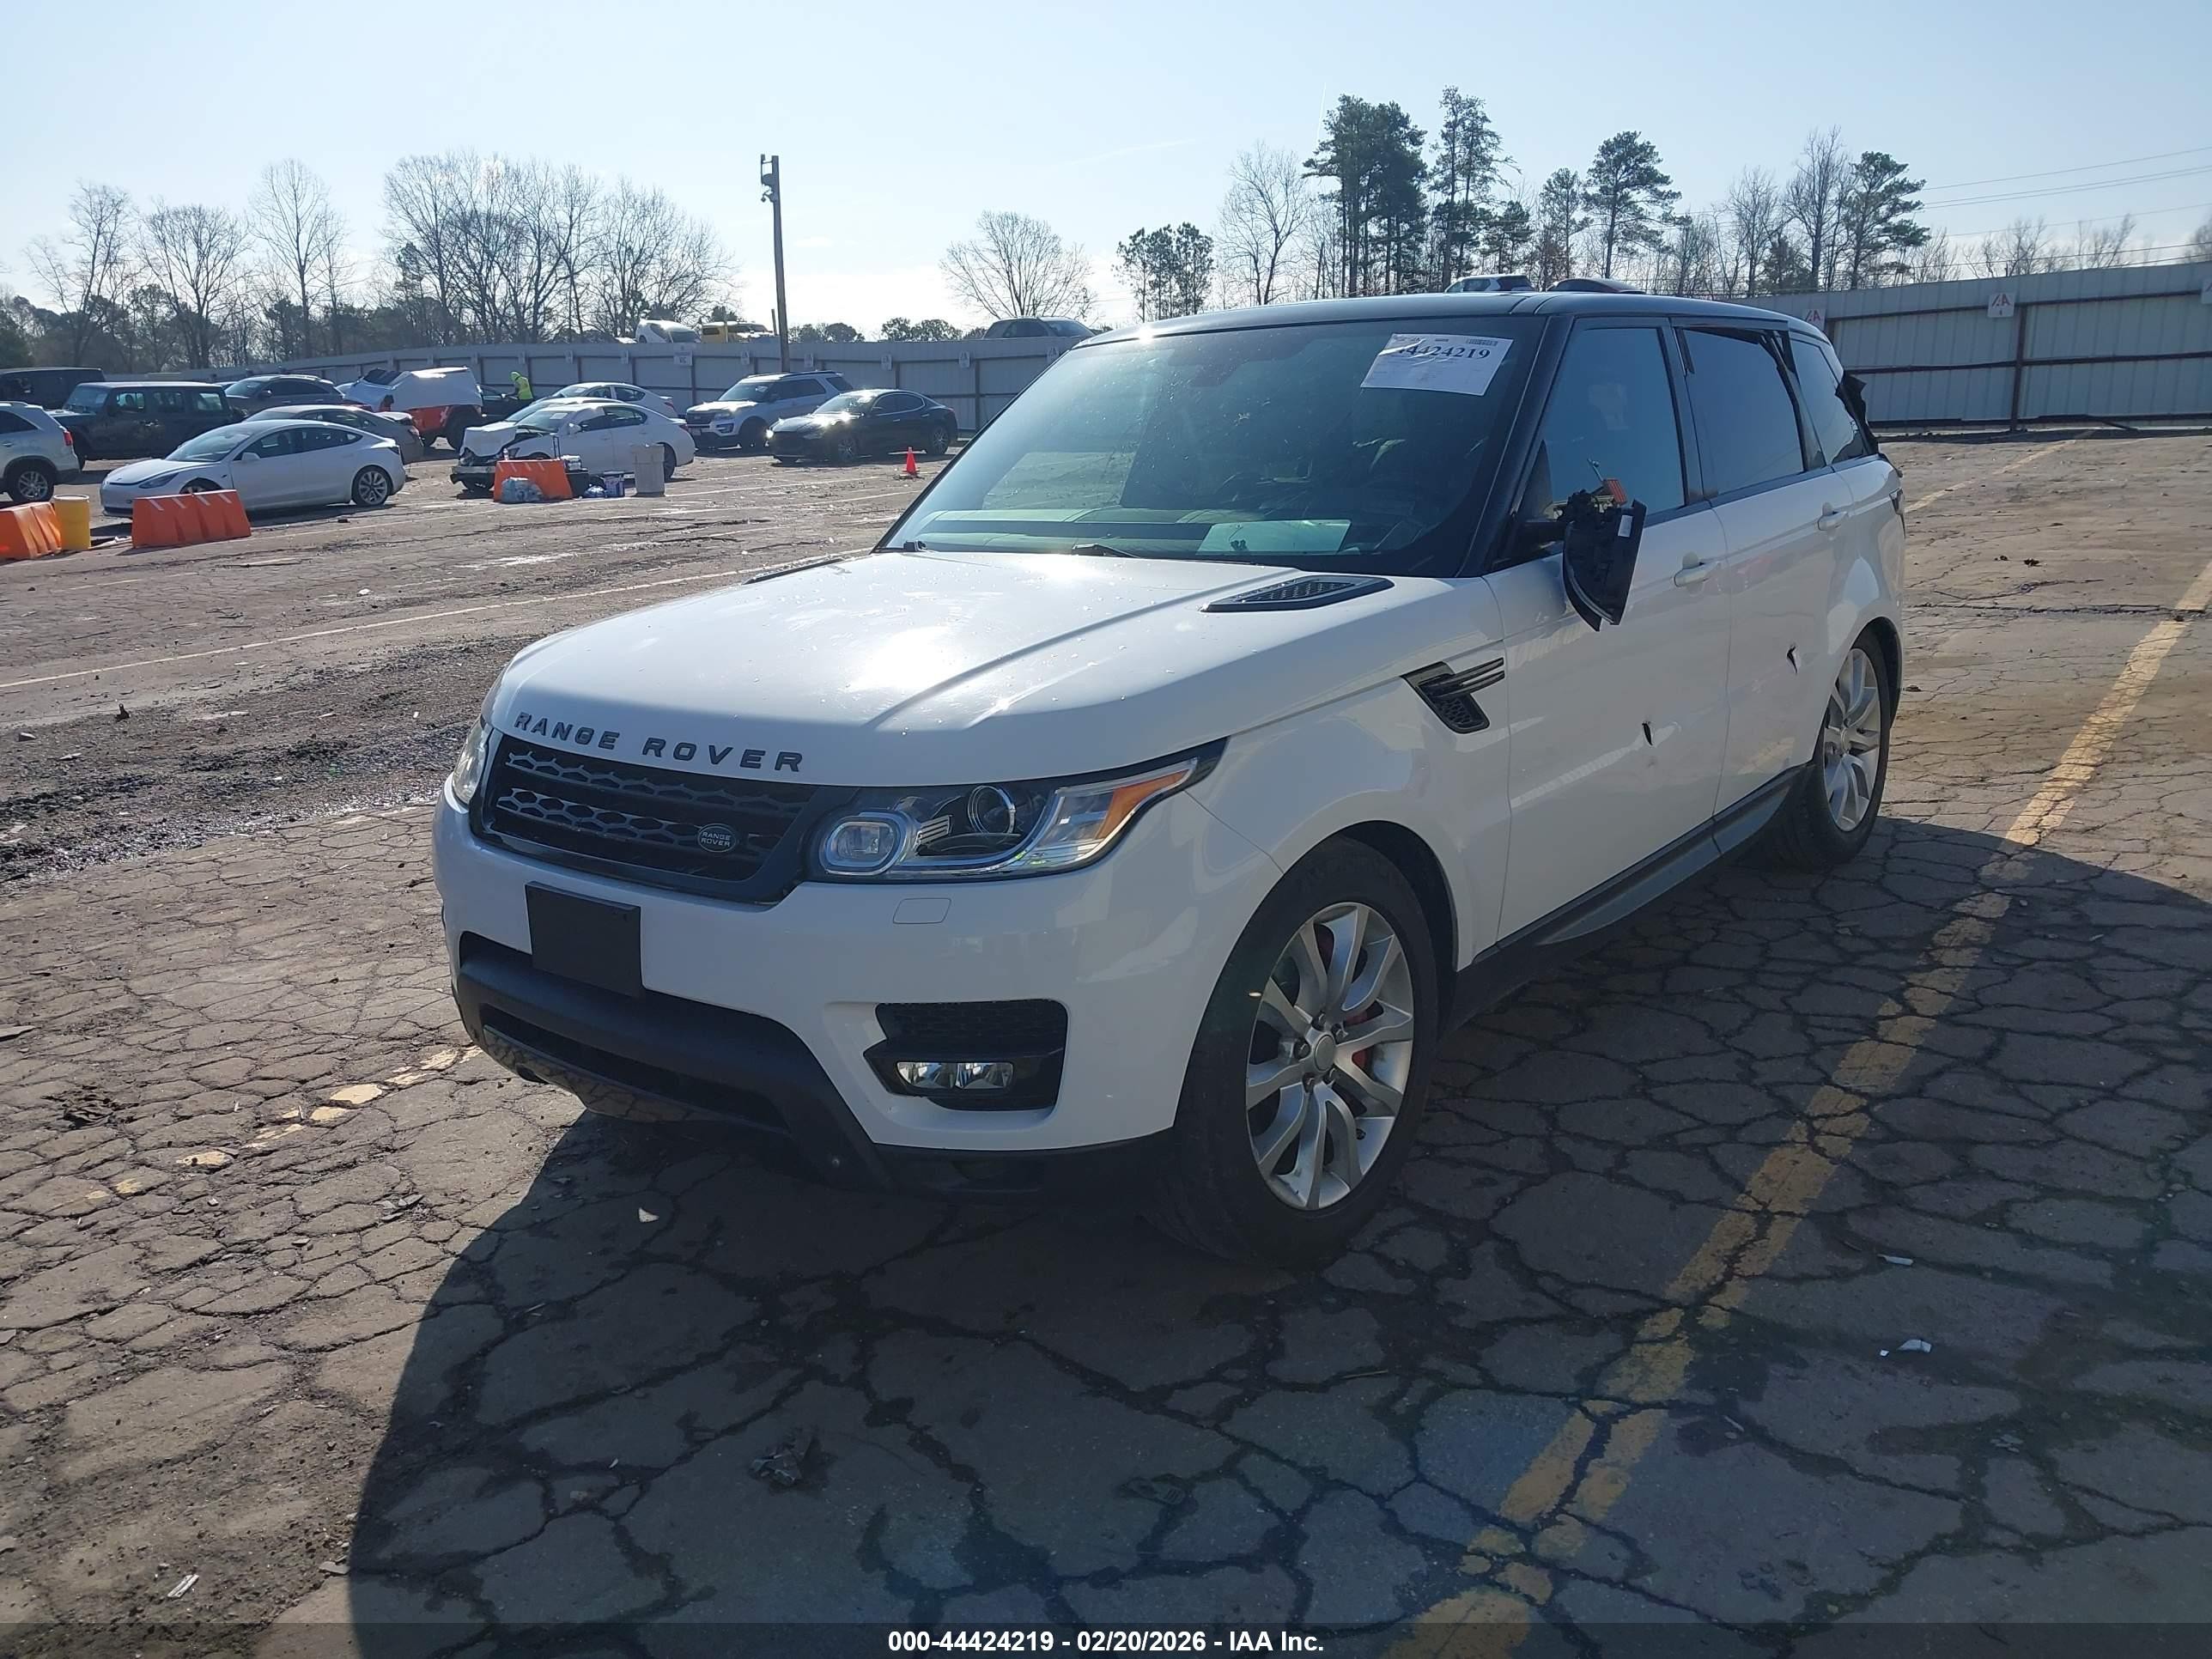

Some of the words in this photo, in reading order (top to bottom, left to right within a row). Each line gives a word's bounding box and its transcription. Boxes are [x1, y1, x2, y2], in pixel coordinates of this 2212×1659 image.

[514, 712, 620, 750] RANGE
[642, 737, 803, 772] ROVER
[702, 831, 732, 841] RANGE
[701, 837, 731, 848] ROVER
